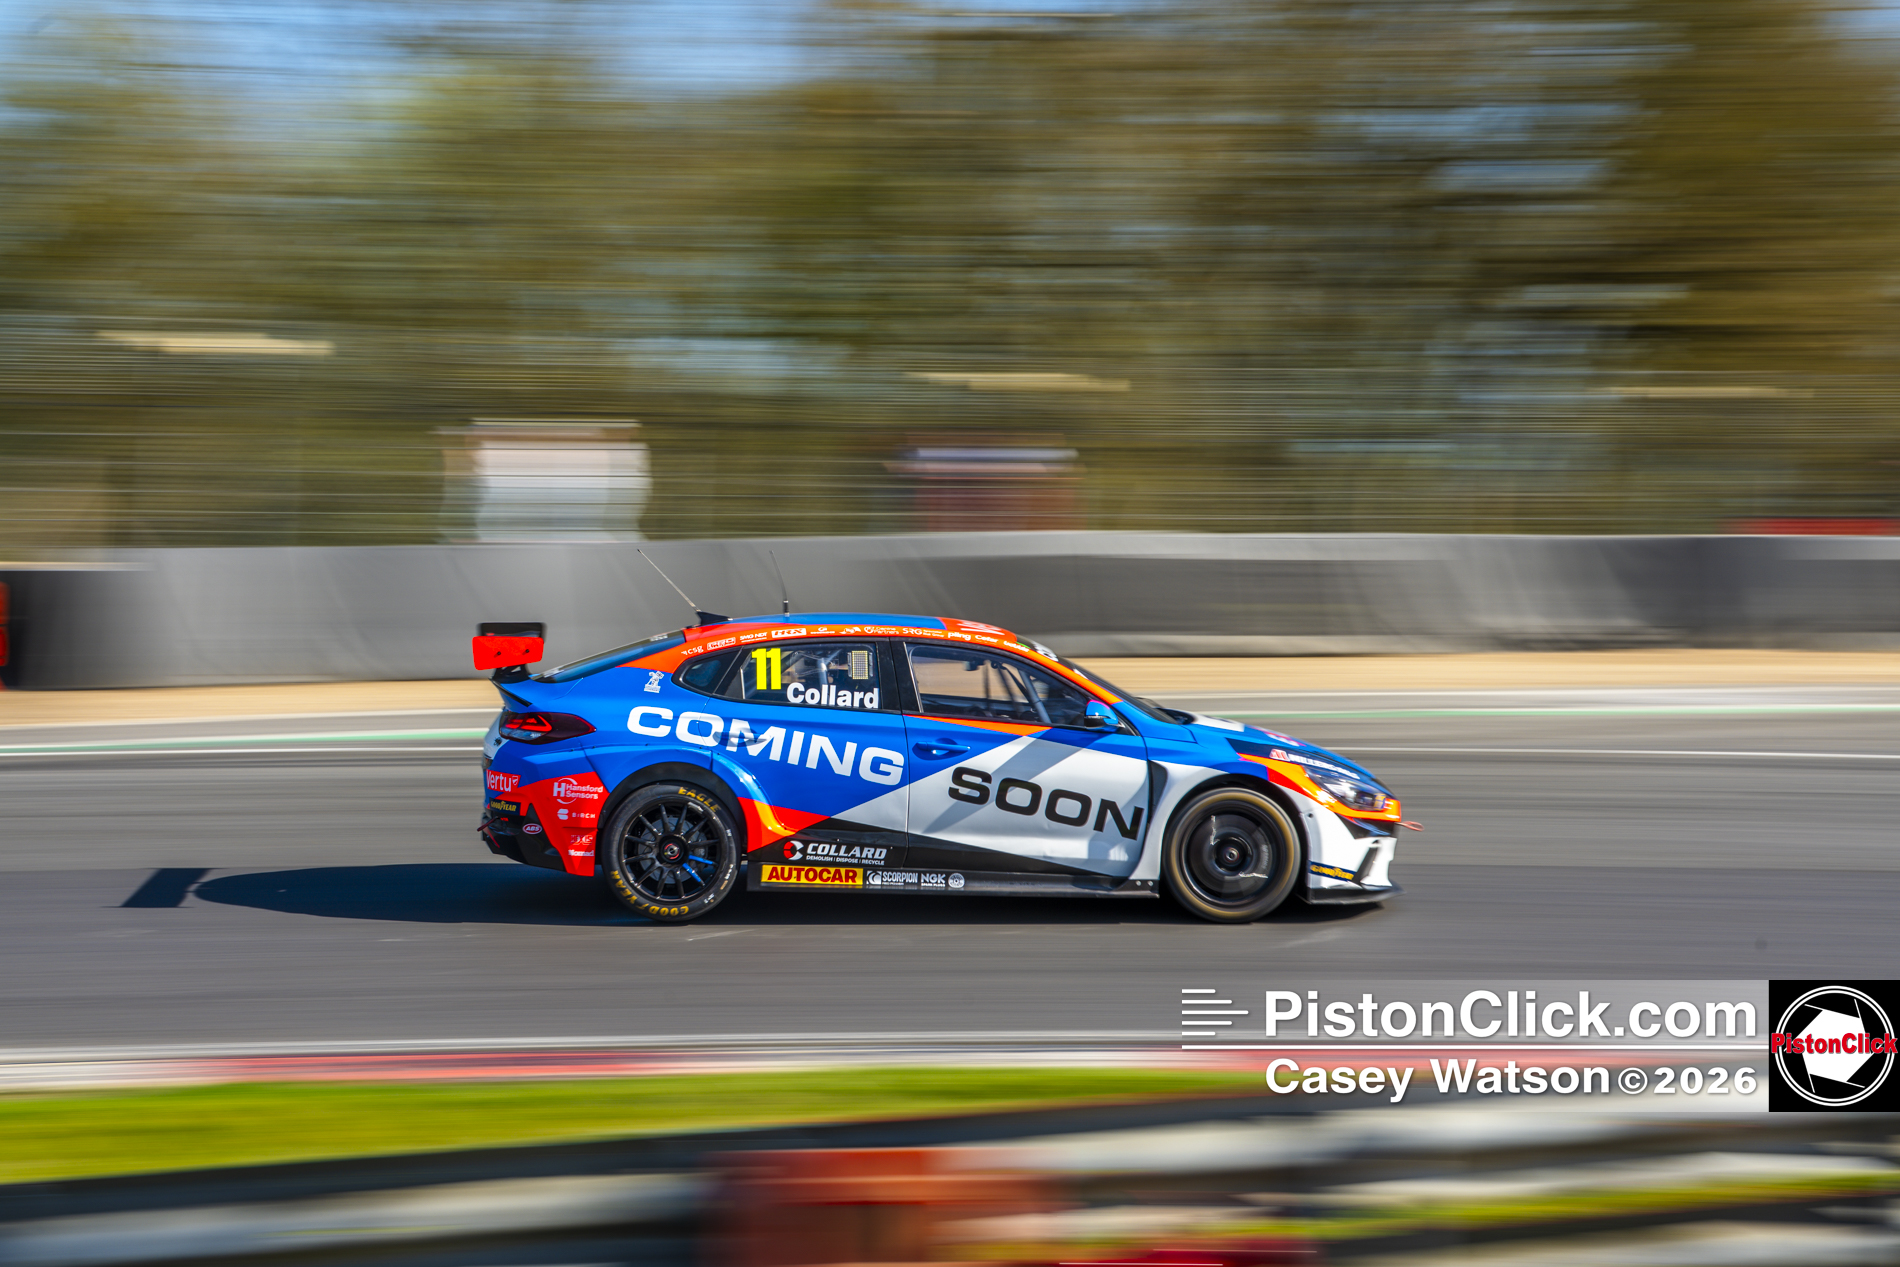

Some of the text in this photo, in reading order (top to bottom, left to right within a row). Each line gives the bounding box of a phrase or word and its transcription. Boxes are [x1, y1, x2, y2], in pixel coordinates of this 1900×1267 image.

[902, 627, 923, 636] SRG
[752, 648, 782, 690] 11
[786, 682, 879, 708] Collard
[627, 706, 905, 786] COMING
[486, 769, 512, 792] Vertu
[566, 783, 603, 793] Hansford
[566, 790, 599, 800] Sensors
[678, 787, 721, 813] EAGLE
[948, 766, 1145, 841] SOON
[806, 842, 887, 860] COLLARD
[767, 866, 858, 884] AUTOCAR
[882, 871, 919, 884] SCORPION
[921, 873, 946, 884] NGK
[611, 870, 689, 917] GOODYEAR
